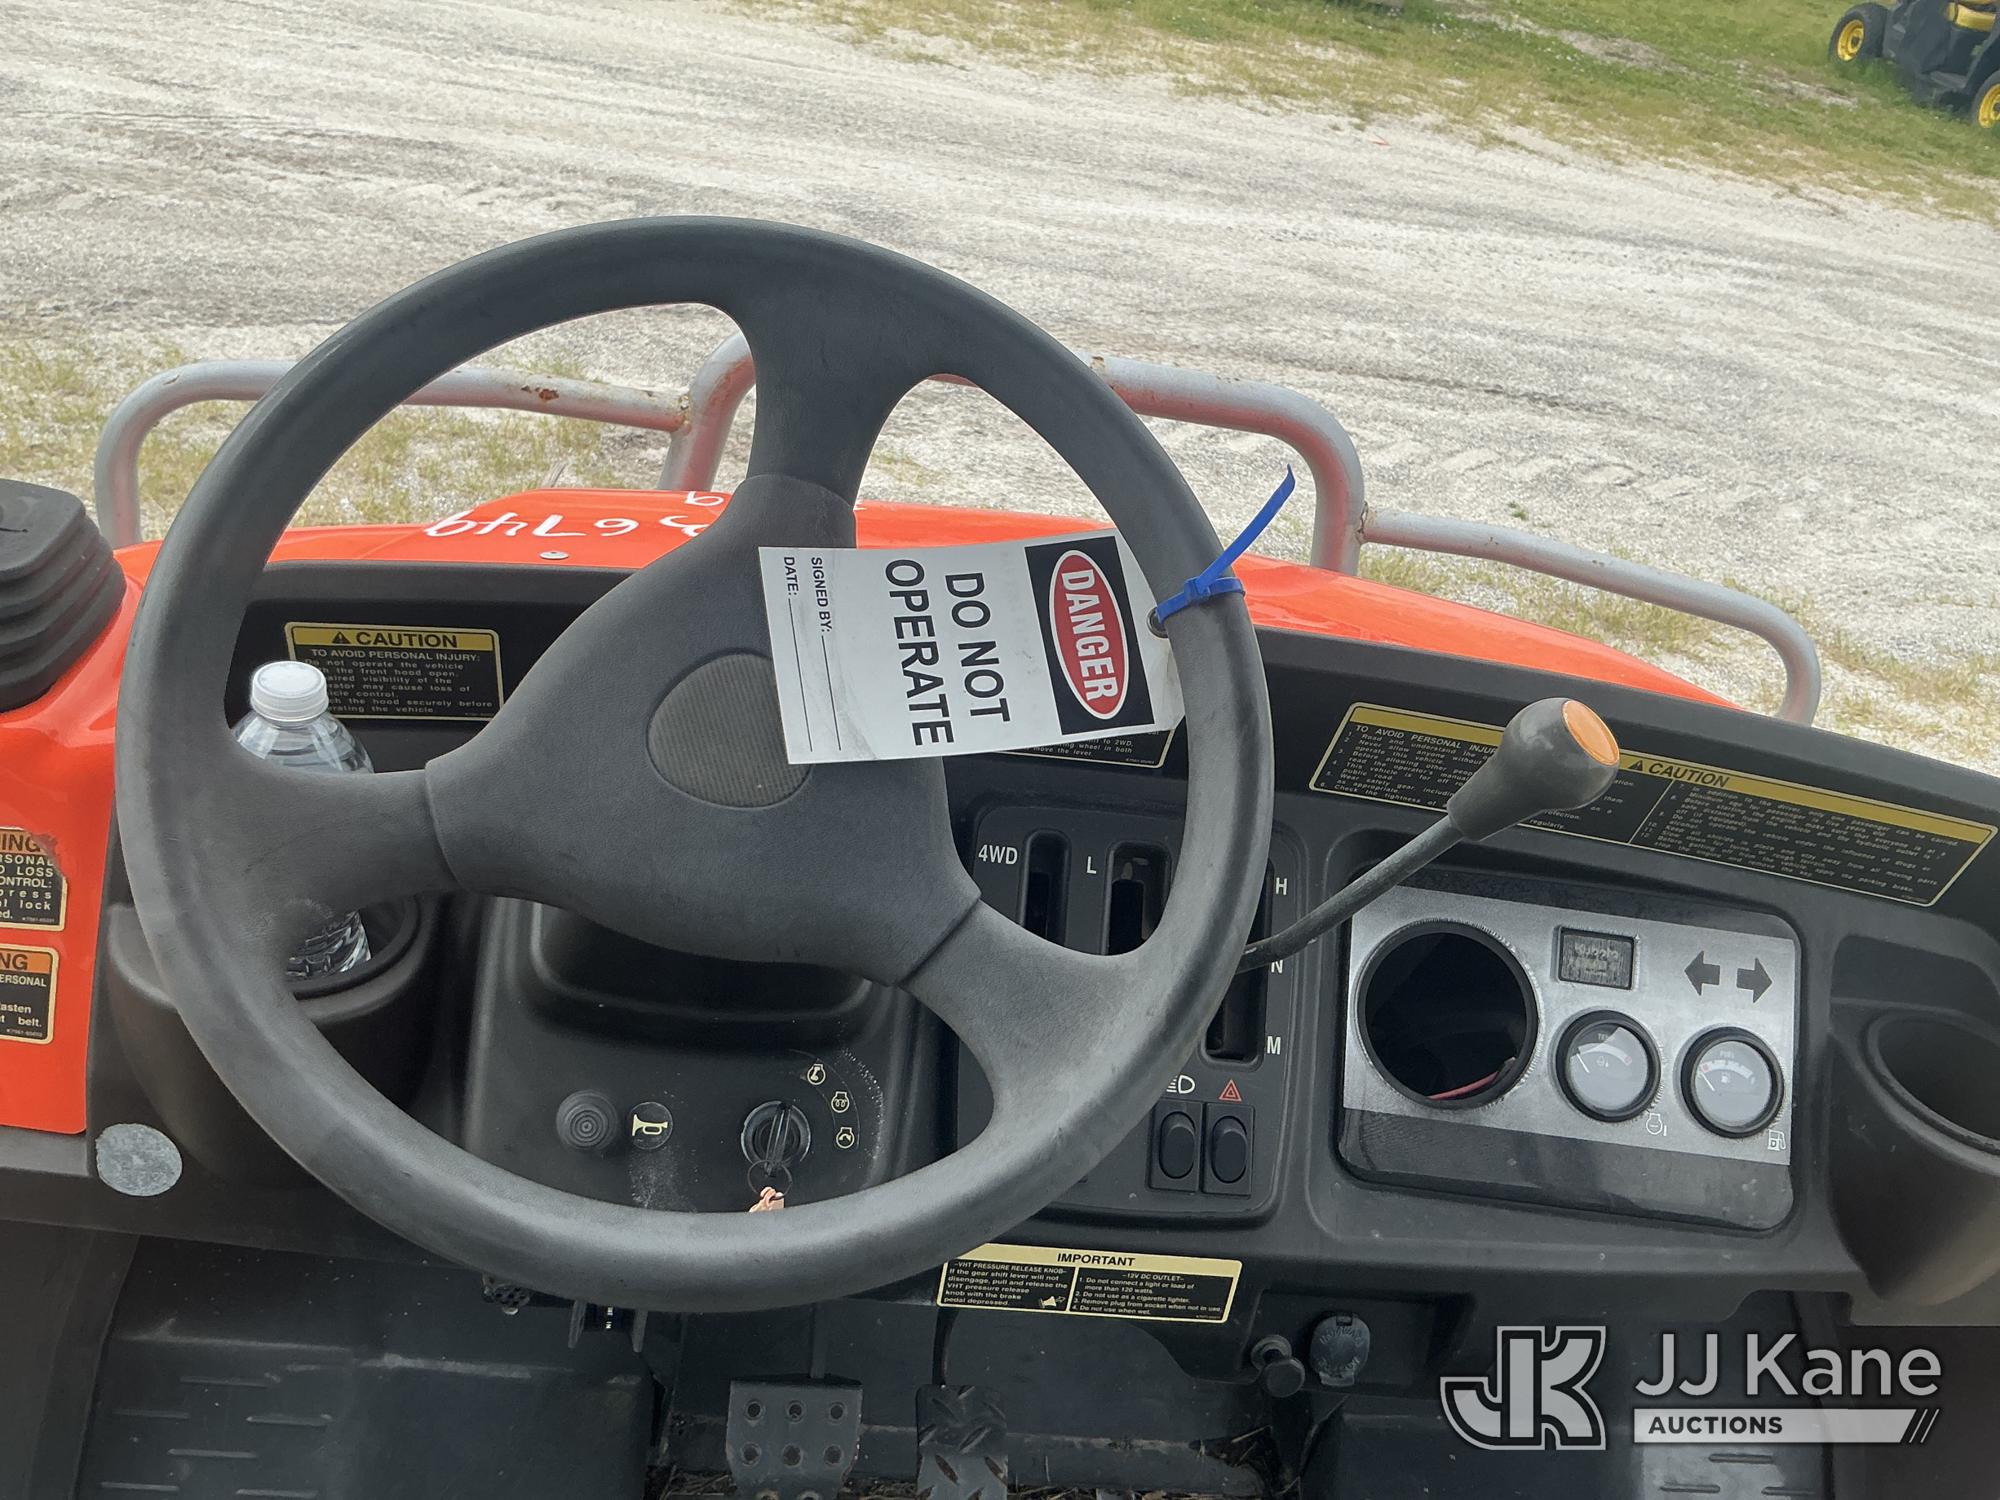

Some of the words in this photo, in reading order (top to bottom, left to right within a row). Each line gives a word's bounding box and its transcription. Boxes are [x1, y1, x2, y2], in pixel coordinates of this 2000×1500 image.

[783, 556, 799, 598] DATE:
[810, 556, 829, 610] SIGNED
[945, 573, 992, 629] DO
[818, 610, 834, 633] BY:
[356, 631, 458, 648] CAUTION
[1062, 568, 1118, 702] DANGER
[311, 649, 327, 657] TO
[330, 649, 366, 658] AVOID
[368, 651, 433, 660] PERSONAL
[436, 653, 481, 661] INJURY:
[885, 559, 954, 746] OPERATE
[352, 660, 394, 668] operate
[362, 676, 411, 684] visibility
[957, 641, 1012, 723] NOT
[407, 700, 452, 708] securely
[1355, 725, 1369, 733] TO
[1375, 728, 1405, 739] AVOID
[1410, 734, 1462, 749] PERSONAL
[1078, 743, 1101, 751] wheel
[1115, 746, 1133, 754] both
[1411, 743, 1457, 755] understand
[1648, 762, 1731, 788] CAUTION
[978, 844, 1019, 866] 4WD
[16, 866, 54, 878] LOSS
[1086, 856, 1097, 875] L
[1275, 877, 1288, 896] H
[19, 898, 51, 911] lock
[1270, 959, 1284, 974] N
[17, 1015, 42, 1028] belt.
[1266, 1036, 1281, 1056] M
[1057, 1253, 1136, 1267] IMPORTANT
[973, 1262, 1010, 1271] PRESSURE
[1011, 1264, 1043, 1273] RELEASE
[990, 1270, 1009, 1278] shift
[965, 1284, 1000, 1292] pressure
[1001, 1286, 1030, 1294] release
[991, 1278, 1008, 1286] pull
[1025, 1280, 1054, 1288] release
[1144, 1280, 1161, 1288] light
[943, 1296, 966, 1304] pedal
[999, 1292, 1022, 1300] brake
